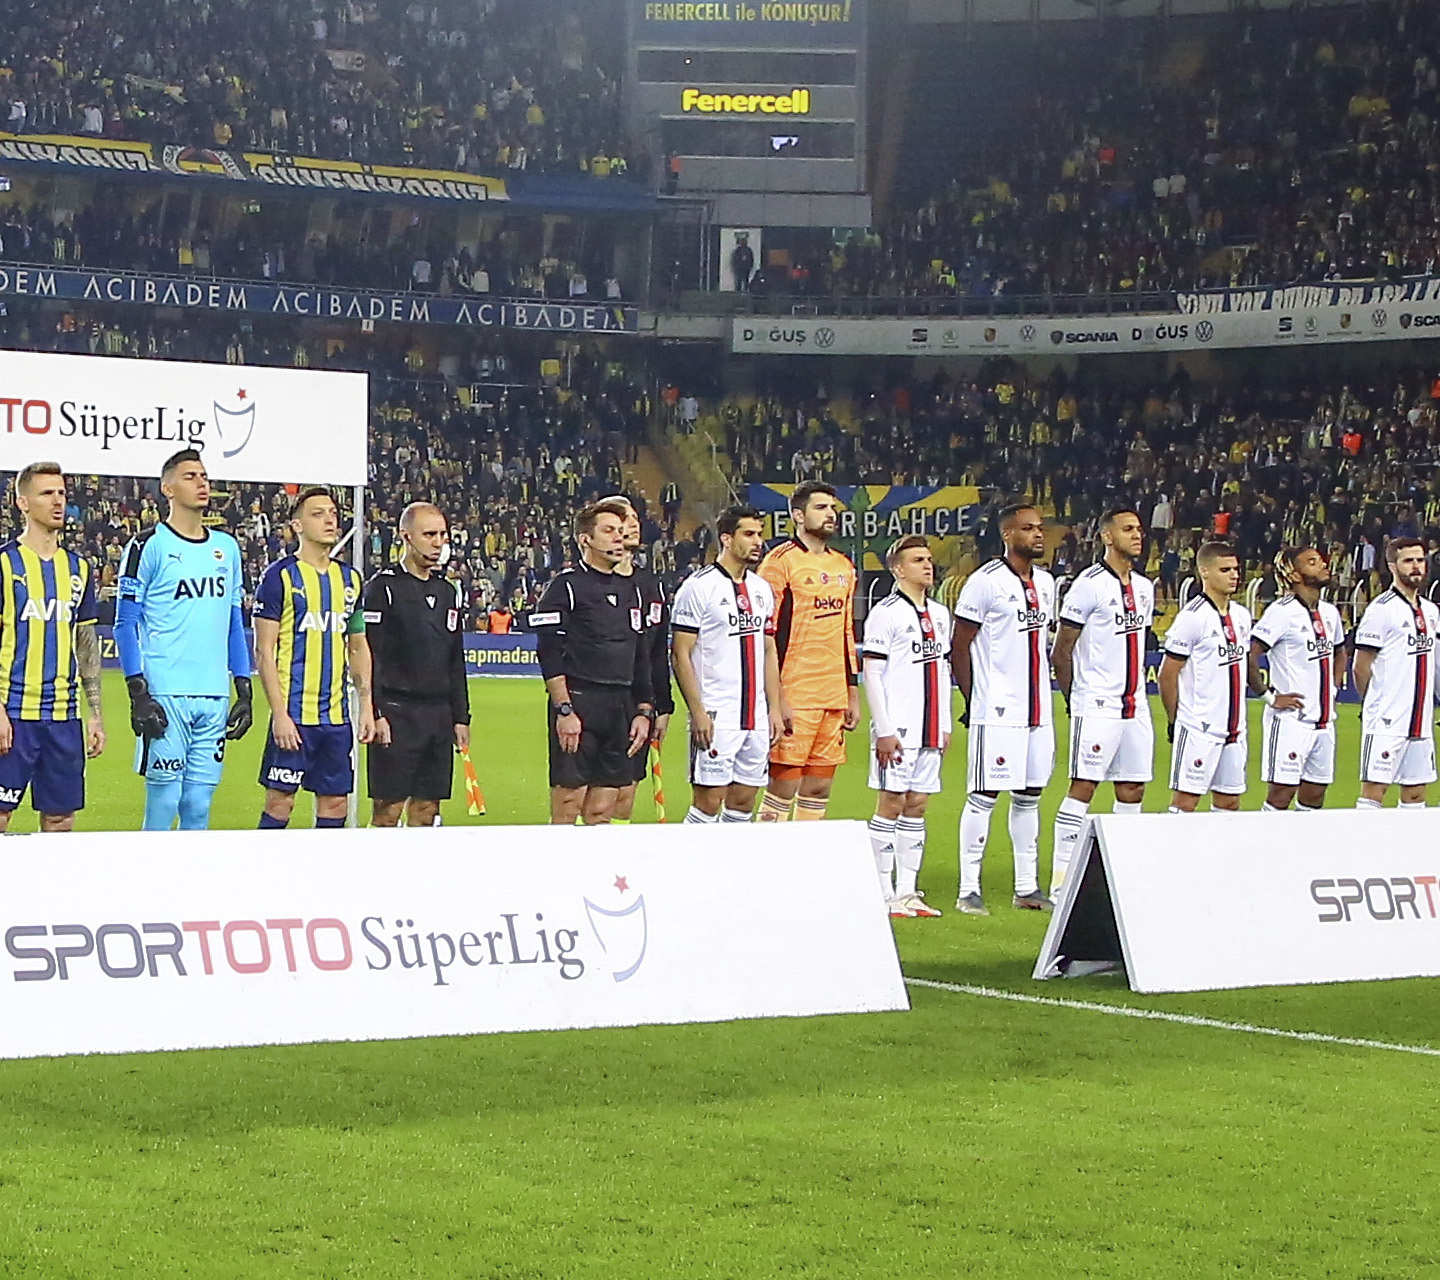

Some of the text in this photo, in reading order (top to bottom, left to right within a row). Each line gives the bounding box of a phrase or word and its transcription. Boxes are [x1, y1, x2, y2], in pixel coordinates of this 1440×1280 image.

[645, 2, 731, 21] FENERCELL
[735, 3, 756, 21] ile
[681, 88, 811, 114] Fenercell
[83, 275, 248, 311] ACIBADEM
[272, 289, 430, 324] ACIBADEM
[1065, 331, 1119, 344] SCANIA
[58, 401, 207, 453] SüperLig
[758, 504, 972, 540] ERBAHÇE
[173, 575, 226, 601] AVIS
[20, 597, 75, 621] AVIS
[813, 595, 844, 610] beko
[298, 611, 348, 632] AVIS
[728, 612, 763, 630] beko
[1016, 608, 1047, 624] beko
[1115, 610, 1145, 626] beko
[911, 639, 943, 655] beko
[1306, 637, 1334, 653] beko
[1407, 633, 1434, 648] beko
[1218, 643, 1245, 659] beko
[151, 757, 184, 772] AYG
[267, 765, 305, 785] AYGAZ
[4, 912, 586, 989] SPORTOTO SüperLig
